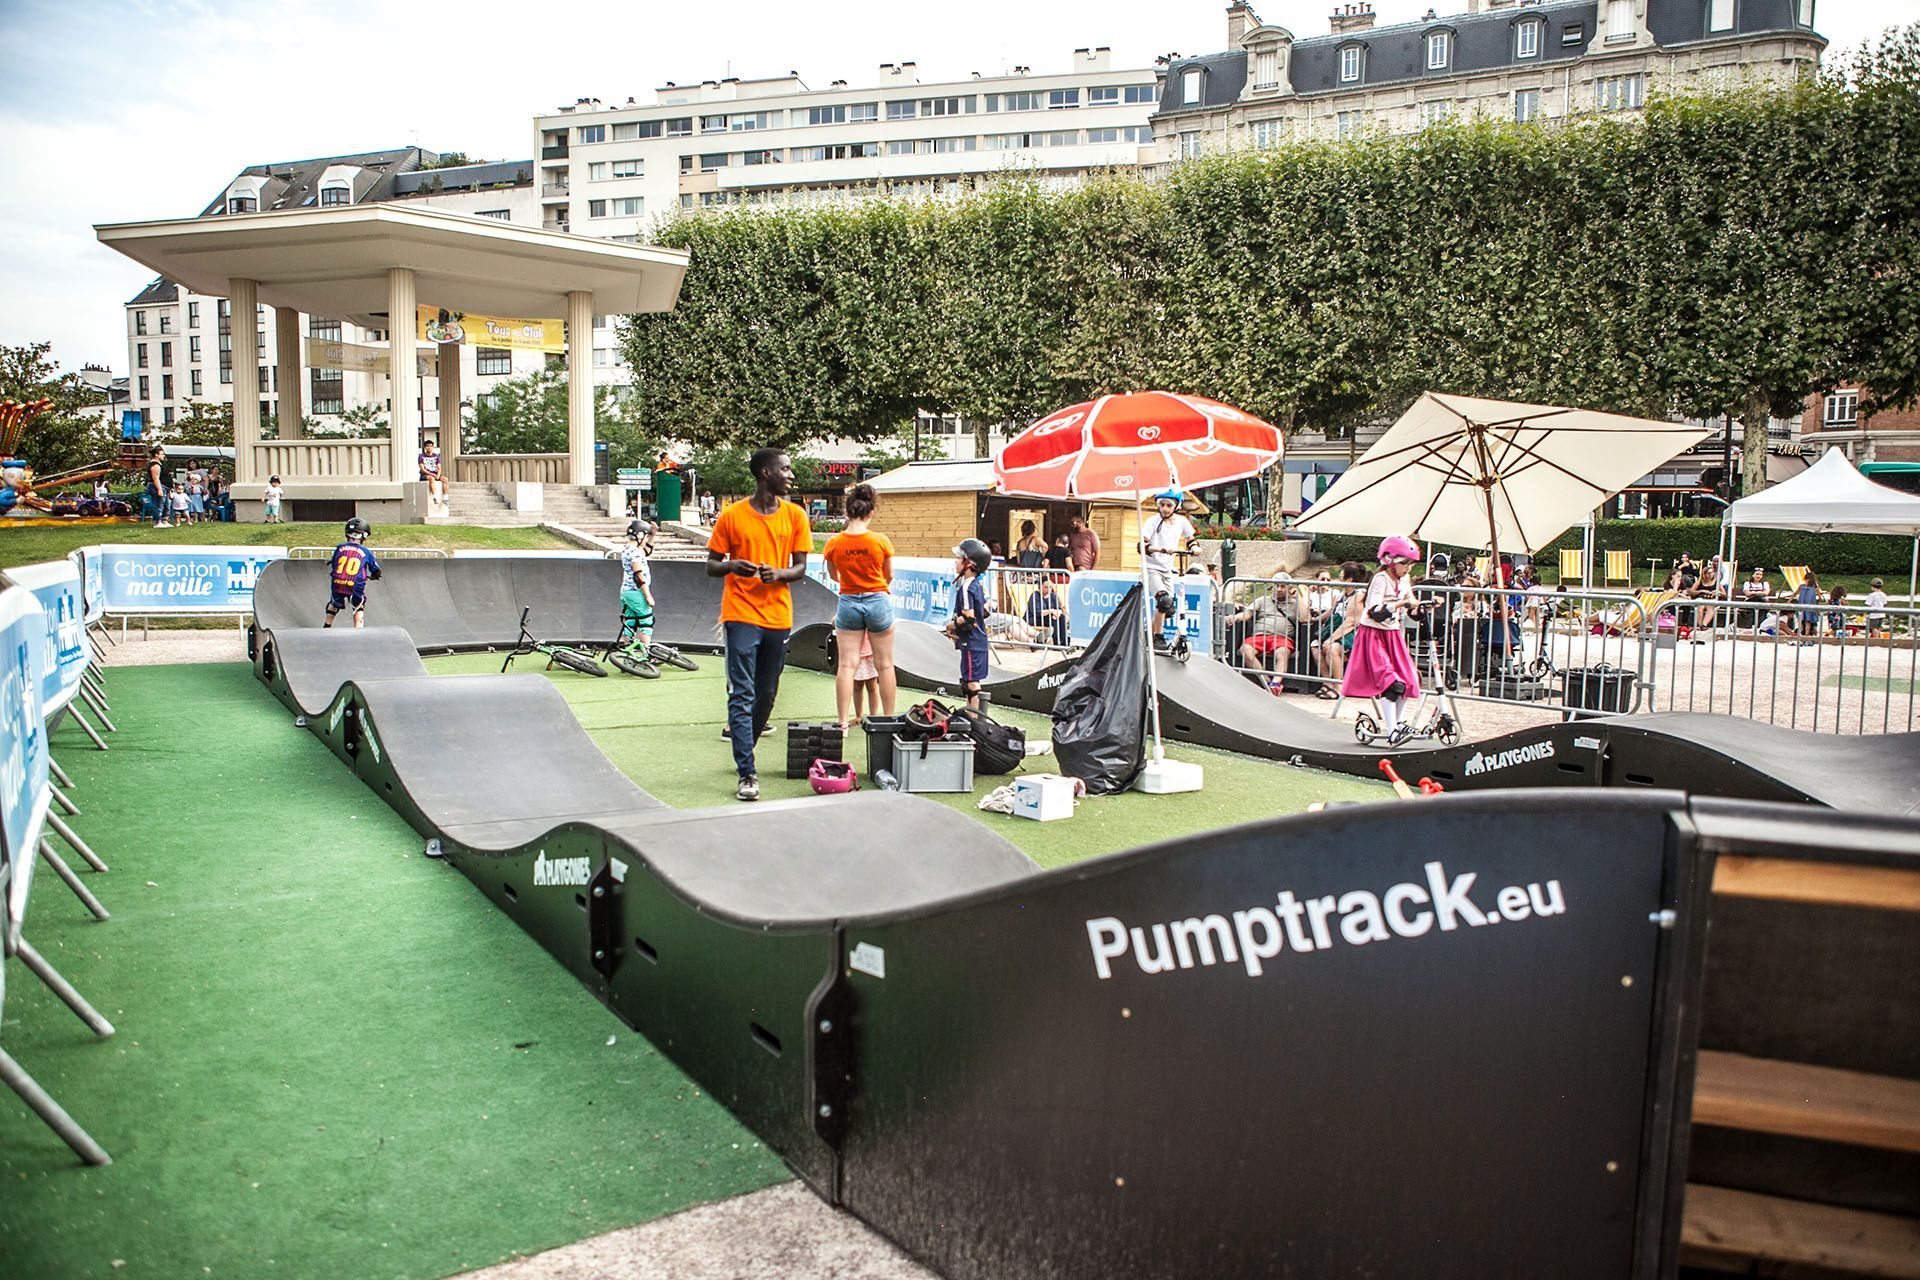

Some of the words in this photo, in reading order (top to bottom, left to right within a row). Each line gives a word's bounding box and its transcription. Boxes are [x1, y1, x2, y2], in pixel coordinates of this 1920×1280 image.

[485, 321, 511, 336] Tous
[523, 325, 544, 338] Club
[114, 560, 220, 577] Charenton
[336, 556, 361, 576] 10
[126, 580, 163, 596] ma
[167, 577, 213, 596] ville
[1484, 740, 1555, 772] PLAYGONES
[1086, 861, 1566, 979] Pumptrack.eu
